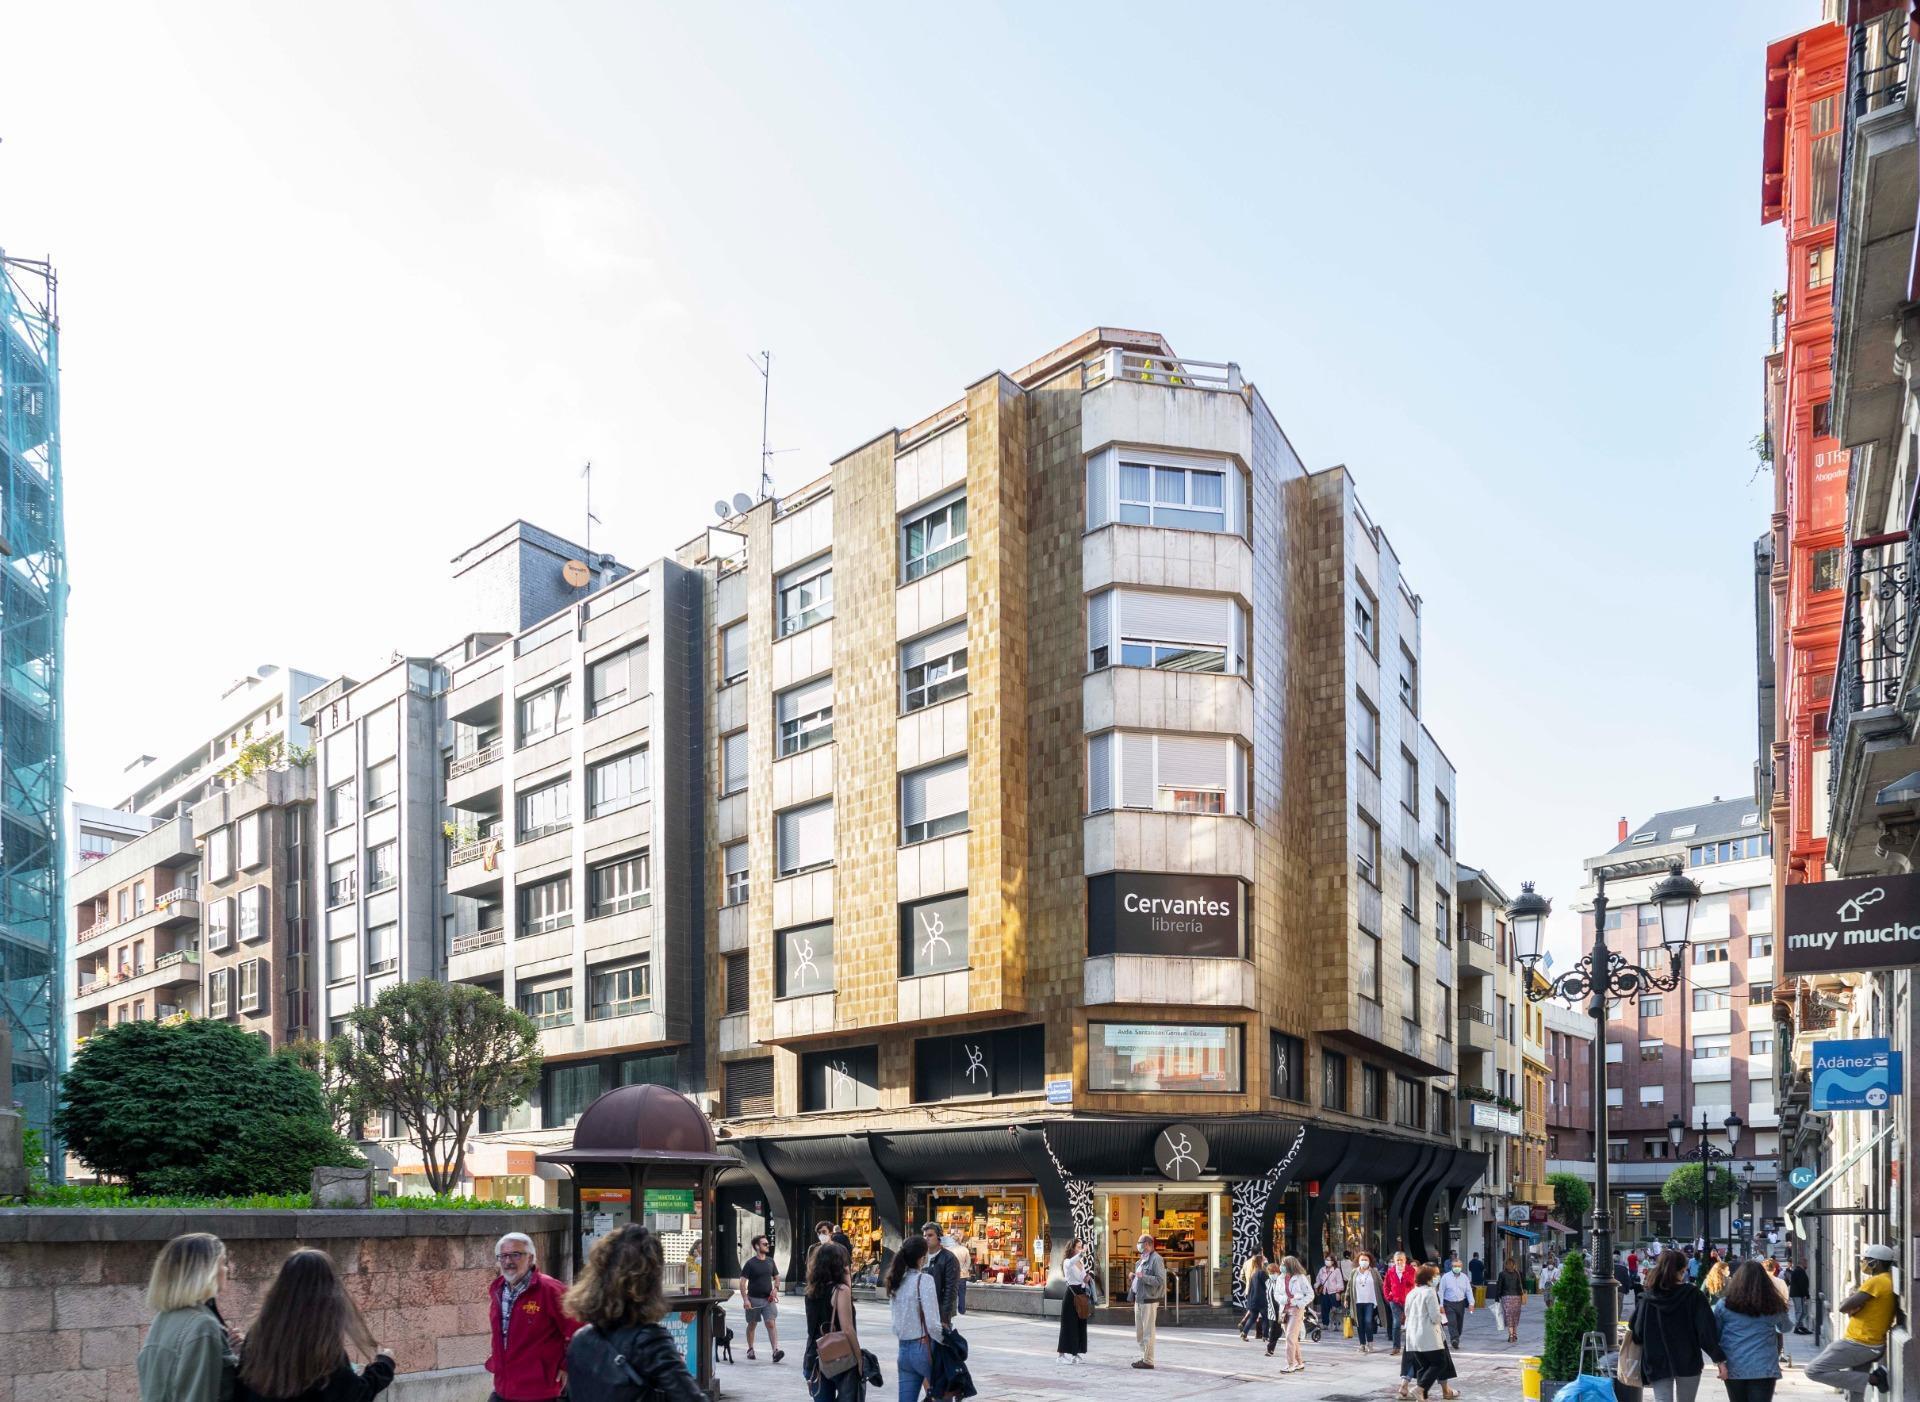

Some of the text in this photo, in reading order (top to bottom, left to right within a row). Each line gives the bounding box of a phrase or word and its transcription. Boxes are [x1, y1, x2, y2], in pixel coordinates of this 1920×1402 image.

[1124, 893, 1230, 917] Cervantes
[1151, 916, 1203, 933] librería
[1788, 922, 1920, 951] muy mucho
[1816, 1056, 1872, 1069] Adánez
